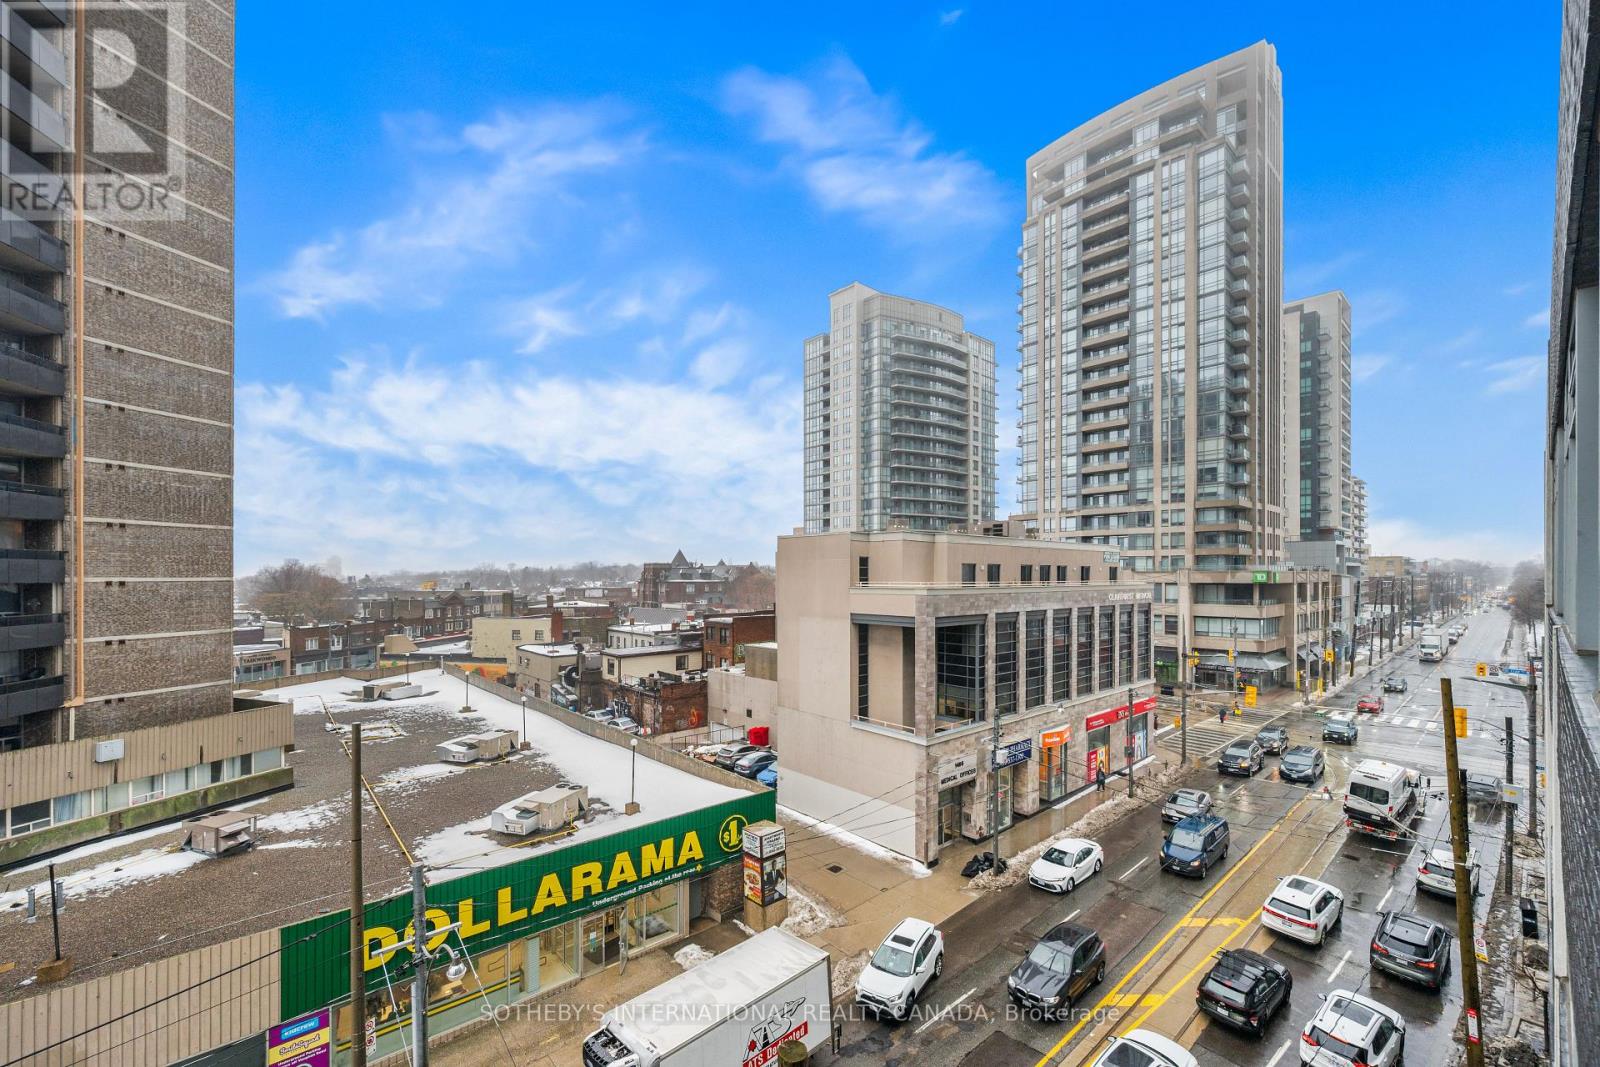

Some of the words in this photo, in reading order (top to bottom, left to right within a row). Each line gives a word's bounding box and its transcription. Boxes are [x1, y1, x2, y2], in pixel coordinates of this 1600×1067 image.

[941, 775, 958, 784] MEDICAL
[960, 768, 976, 778] OFFICES
[363, 831, 704, 972] DOLLARAMA
[592, 887, 637, 907] Underground
[638, 878, 663, 892] Parking
[748, 1053, 764, 1067] ATS
